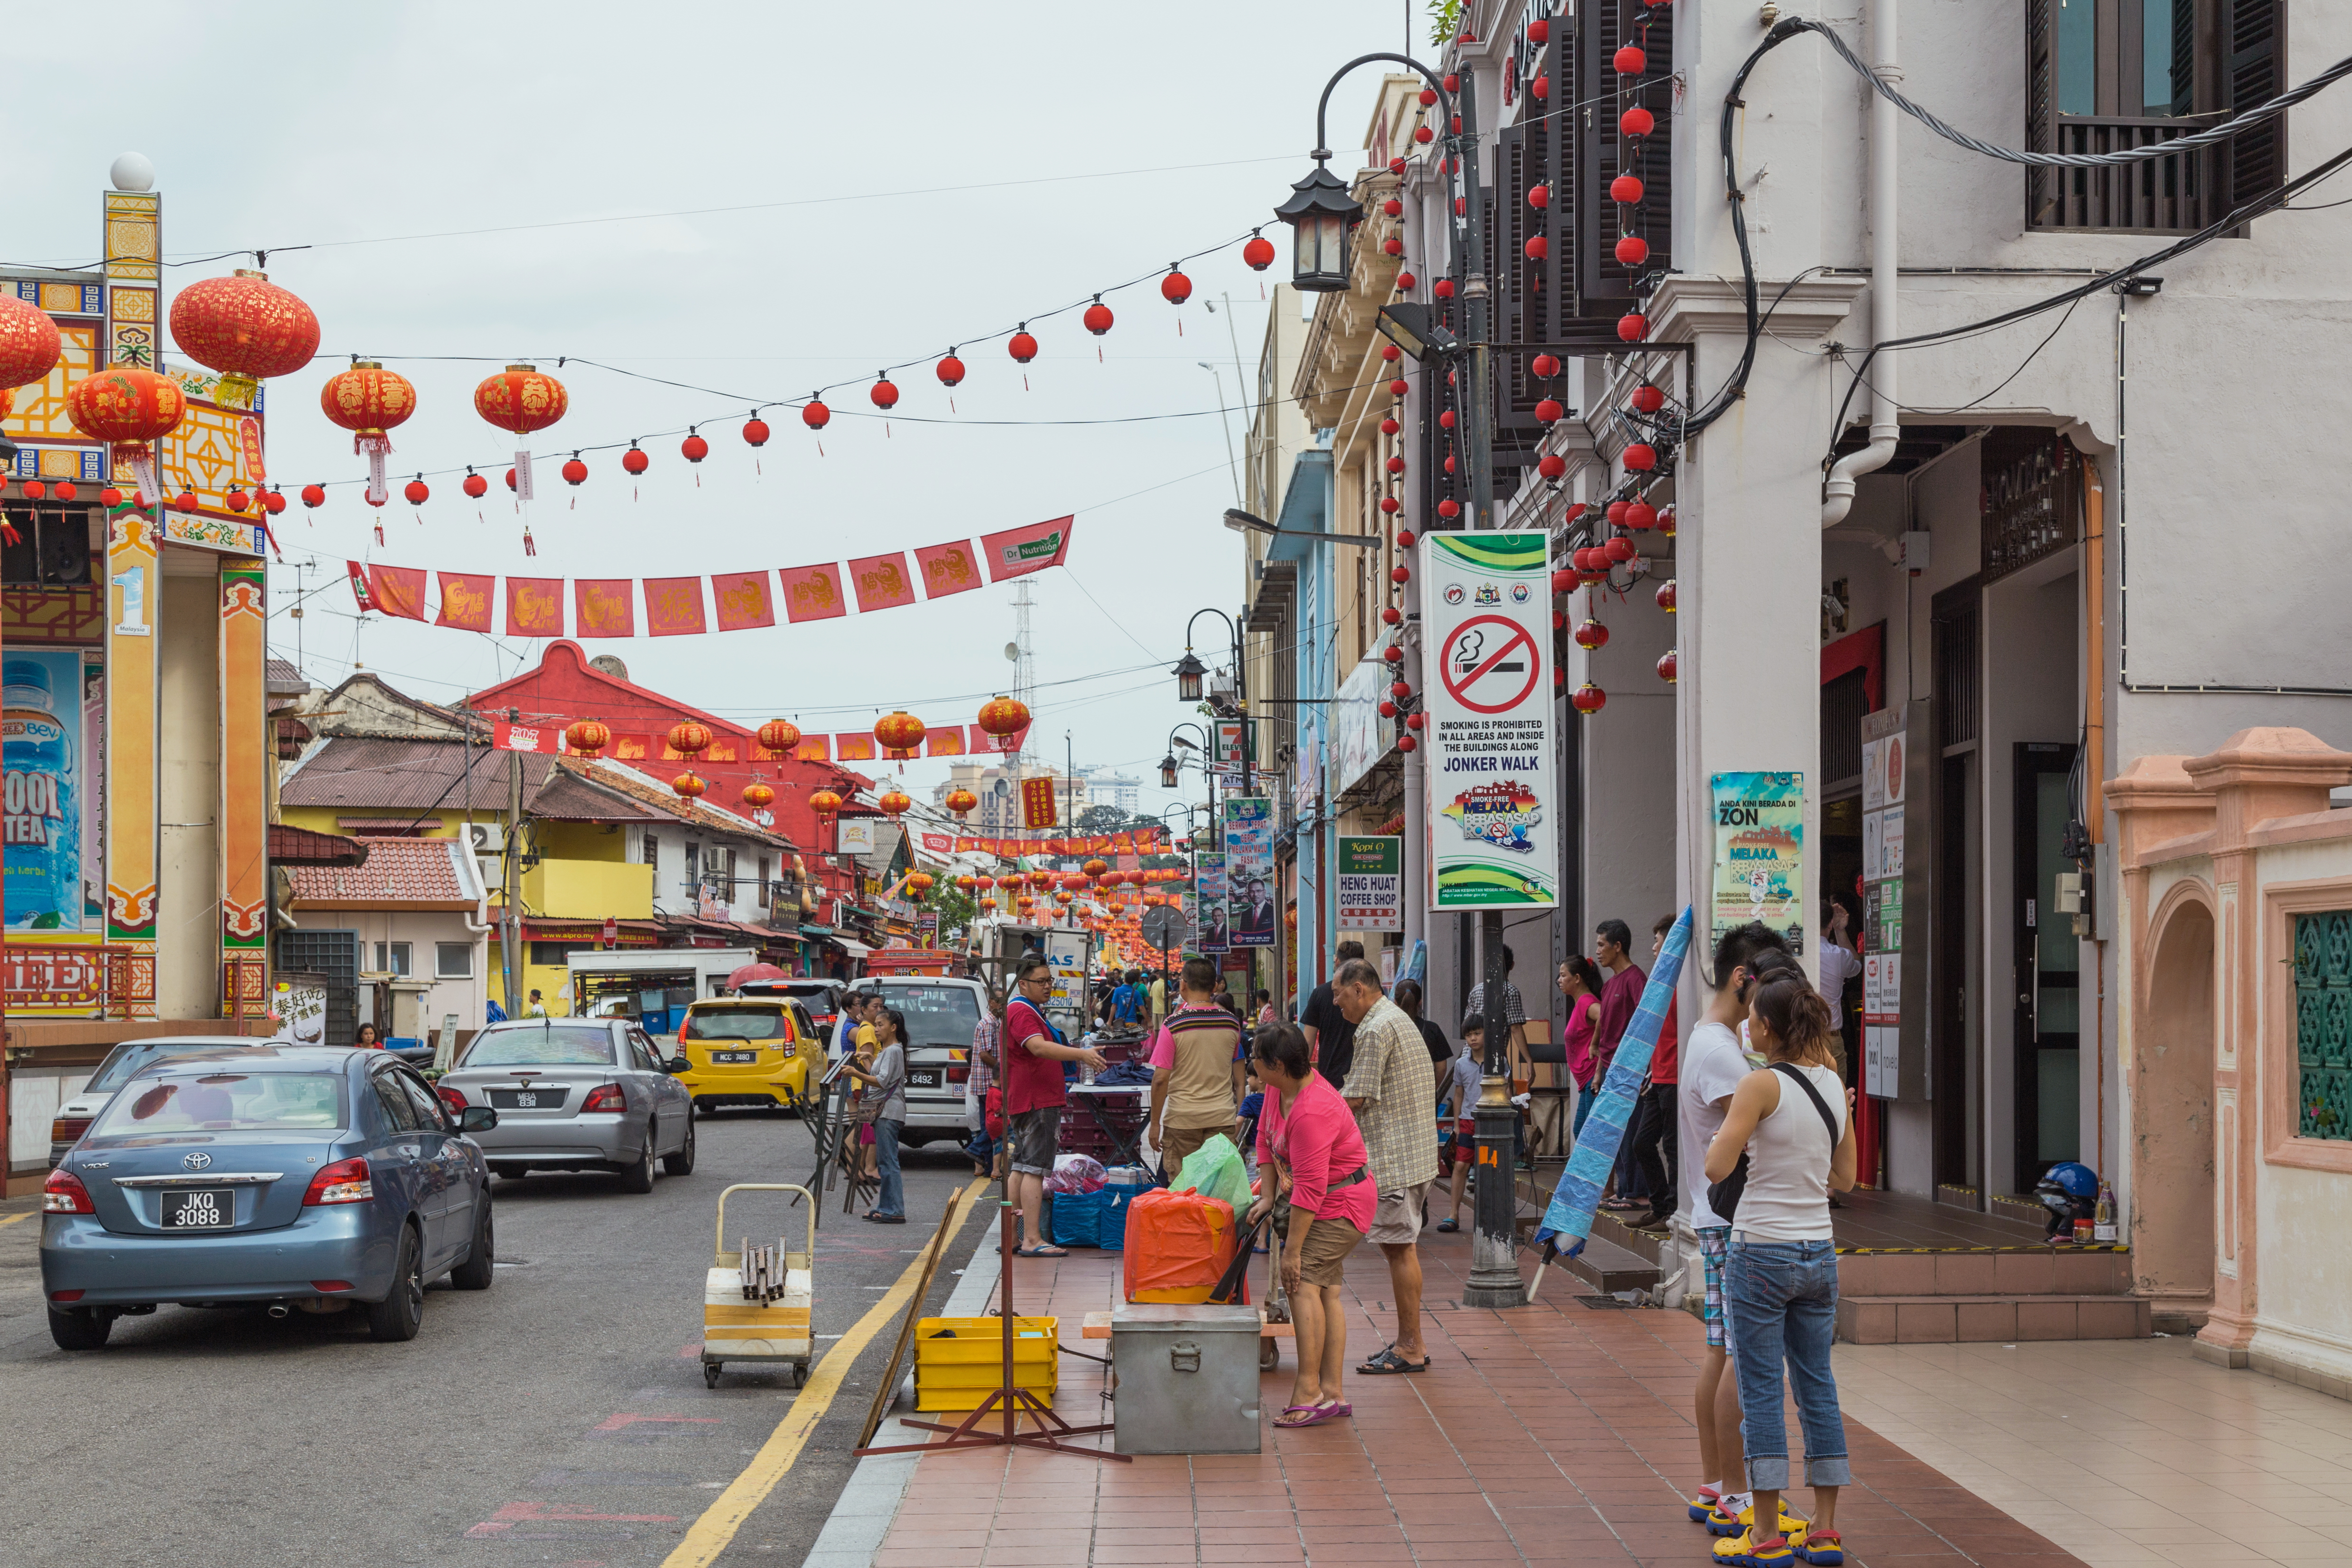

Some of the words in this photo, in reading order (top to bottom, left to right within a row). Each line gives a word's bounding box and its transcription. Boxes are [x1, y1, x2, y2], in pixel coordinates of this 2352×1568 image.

[244, 427, 262, 474] 永春會館
[1007, 550, 1018, 558] Dr
[1021, 543, 1057, 556] Nutrition
[860, 570, 877, 594] 福
[467, 592, 485, 615] 福
[538, 595, 555, 619] 福
[608, 595, 625, 619] 福
[658, 588, 694, 623] 猴
[119, 625, 146, 633] Malaysia
[3, 724, 21, 732] MEE
[27, 722, 57, 738] Bev
[1440, 721, 1479, 730] SMOKING
[1482, 721, 1490, 730] IS
[1492, 720, 1543, 729] PROHIBITED
[511, 727, 539, 740] 707
[1439, 732, 1447, 741] IN
[1450, 732, 1466, 741] ALL
[1467, 732, 1495, 741] AREAS
[1497, 732, 1514, 740] AND
[1516, 732, 1544, 740] INSIDE
[1444, 744, 1461, 752] THE
[1463, 743, 1508, 751] BUILDINGS
[1510, 742, 1539, 751] ALONG
[1444, 757, 1498, 772] JONKER
[1501, 756, 1539, 771] WALK
[1463, 801, 1519, 814] MELAKA
[1463, 813, 1505, 825] BEBAS
[1504, 812, 1541, 825] ASAP
[1720, 808, 1758, 826] ZON
[3, 815, 47, 843] TEA
[1228, 820, 1250, 831] BERKAT,
[1251, 820, 1268, 831] TEPAT,
[1240, 834, 1257, 843] CEPAT
[1231, 845, 1252, 854] MELAKA
[1254, 844, 1267, 853] MAJU
[1352, 842, 1374, 852] Kopi
[1241, 855, 1253, 865] FASA
[1730, 848, 1778, 860] MELAKA
[4, 867, 15, 875] eh
[18, 866, 46, 876] Herba
[1730, 859, 1765, 872] BEBAS
[1765, 859, 1796, 872] ASAP
[1341, 876, 1368, 891] HENG
[1371, 877, 1396, 891] HUAT
[1341, 893, 1372, 905] COFFEE
[1374, 893, 1396, 905] SHOP
[274, 985, 325, 1016] 泰好吃
[912, 1075, 933, 1084] 6492
[519, 1099, 536, 1107] 8311
[82, 1162, 110, 1170] VIOS
[181, 1193, 214, 1210] JKQ
[175, 1208, 220, 1226] 3088
